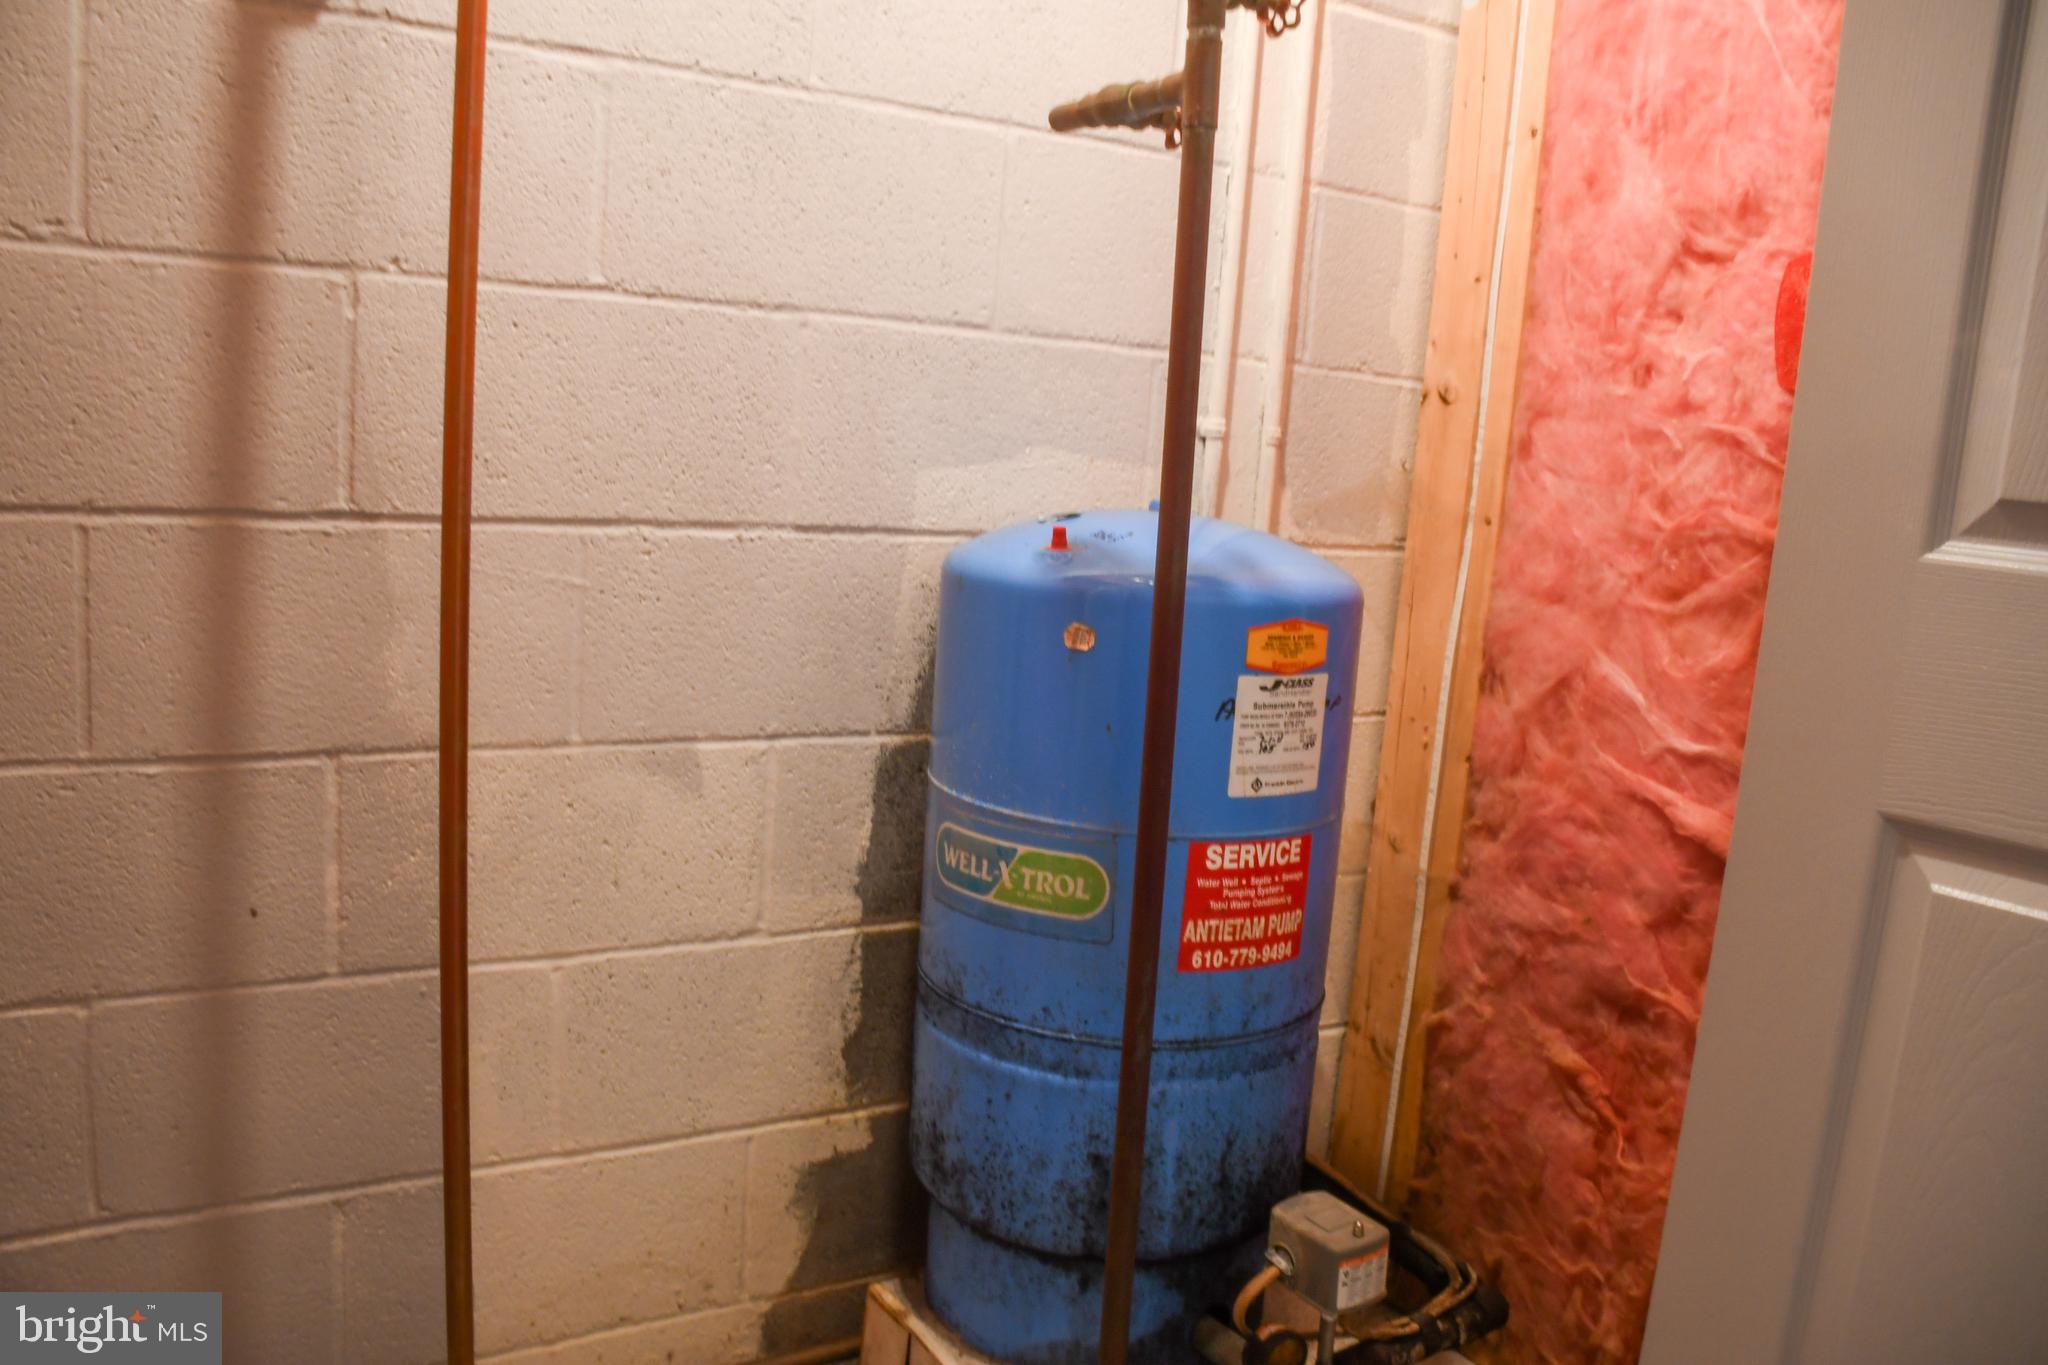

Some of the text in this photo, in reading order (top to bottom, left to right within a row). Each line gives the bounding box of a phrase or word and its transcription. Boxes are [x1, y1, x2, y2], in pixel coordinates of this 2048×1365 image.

[1253, 701, 1296, 711] Submersible
[1298, 700, 1314, 710] Pump
[1206, 839, 1302, 870] SERVICE
[1197, 877, 1220, 888] Water
[1222, 877, 1239, 887] Well
[1251, 875, 1272, 887] Septic
[1223, 887, 1256, 899] Pumping
[1210, 899, 1228, 911] Total
[1230, 899, 1251, 910] Water
[1183, 908, 1303, 943] ANTIETAM PUMP
[1191, 940, 1293, 969] 610-779-9494
